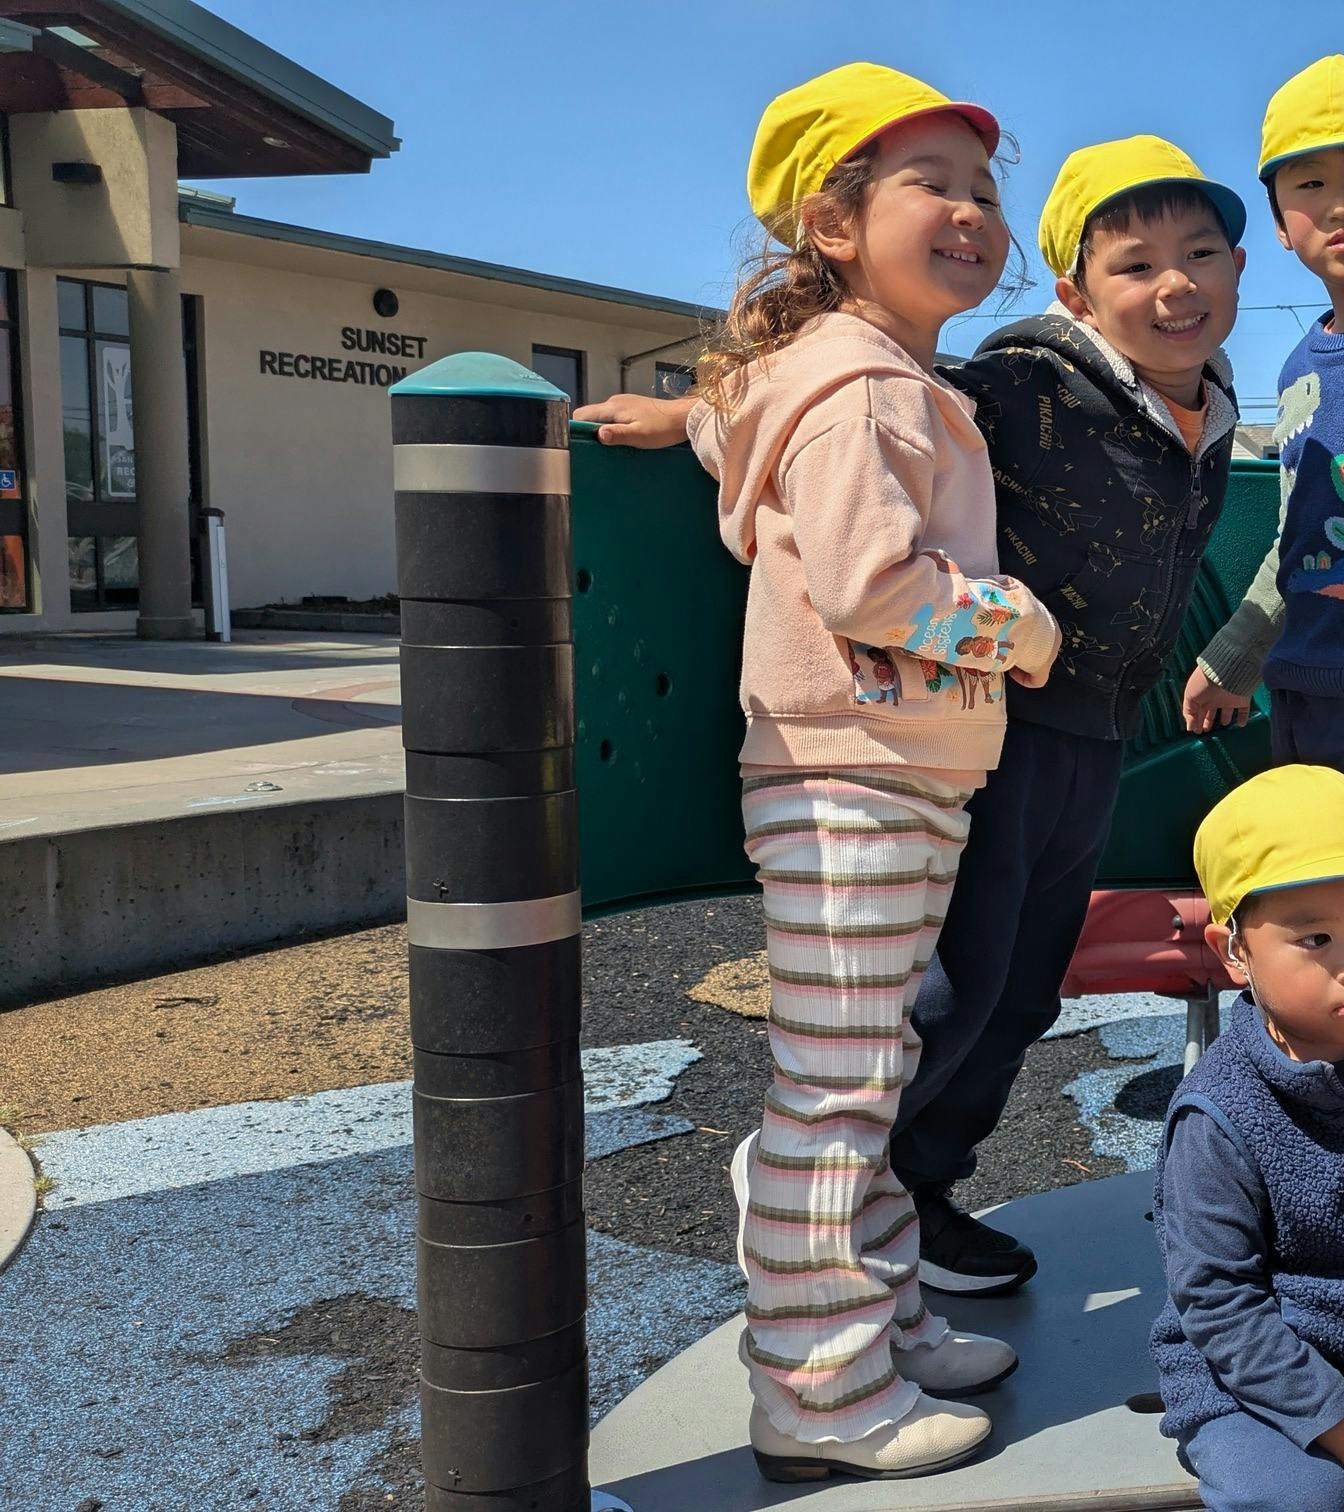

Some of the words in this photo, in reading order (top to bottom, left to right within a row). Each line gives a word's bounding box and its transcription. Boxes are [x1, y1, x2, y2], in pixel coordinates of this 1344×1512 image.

[341, 327, 427, 359] SUNSET
[259, 350, 407, 387] RECREATION
[1038, 394, 1052, 450] PIKACHU
[1004, 527, 1038, 566] PIKACHU
